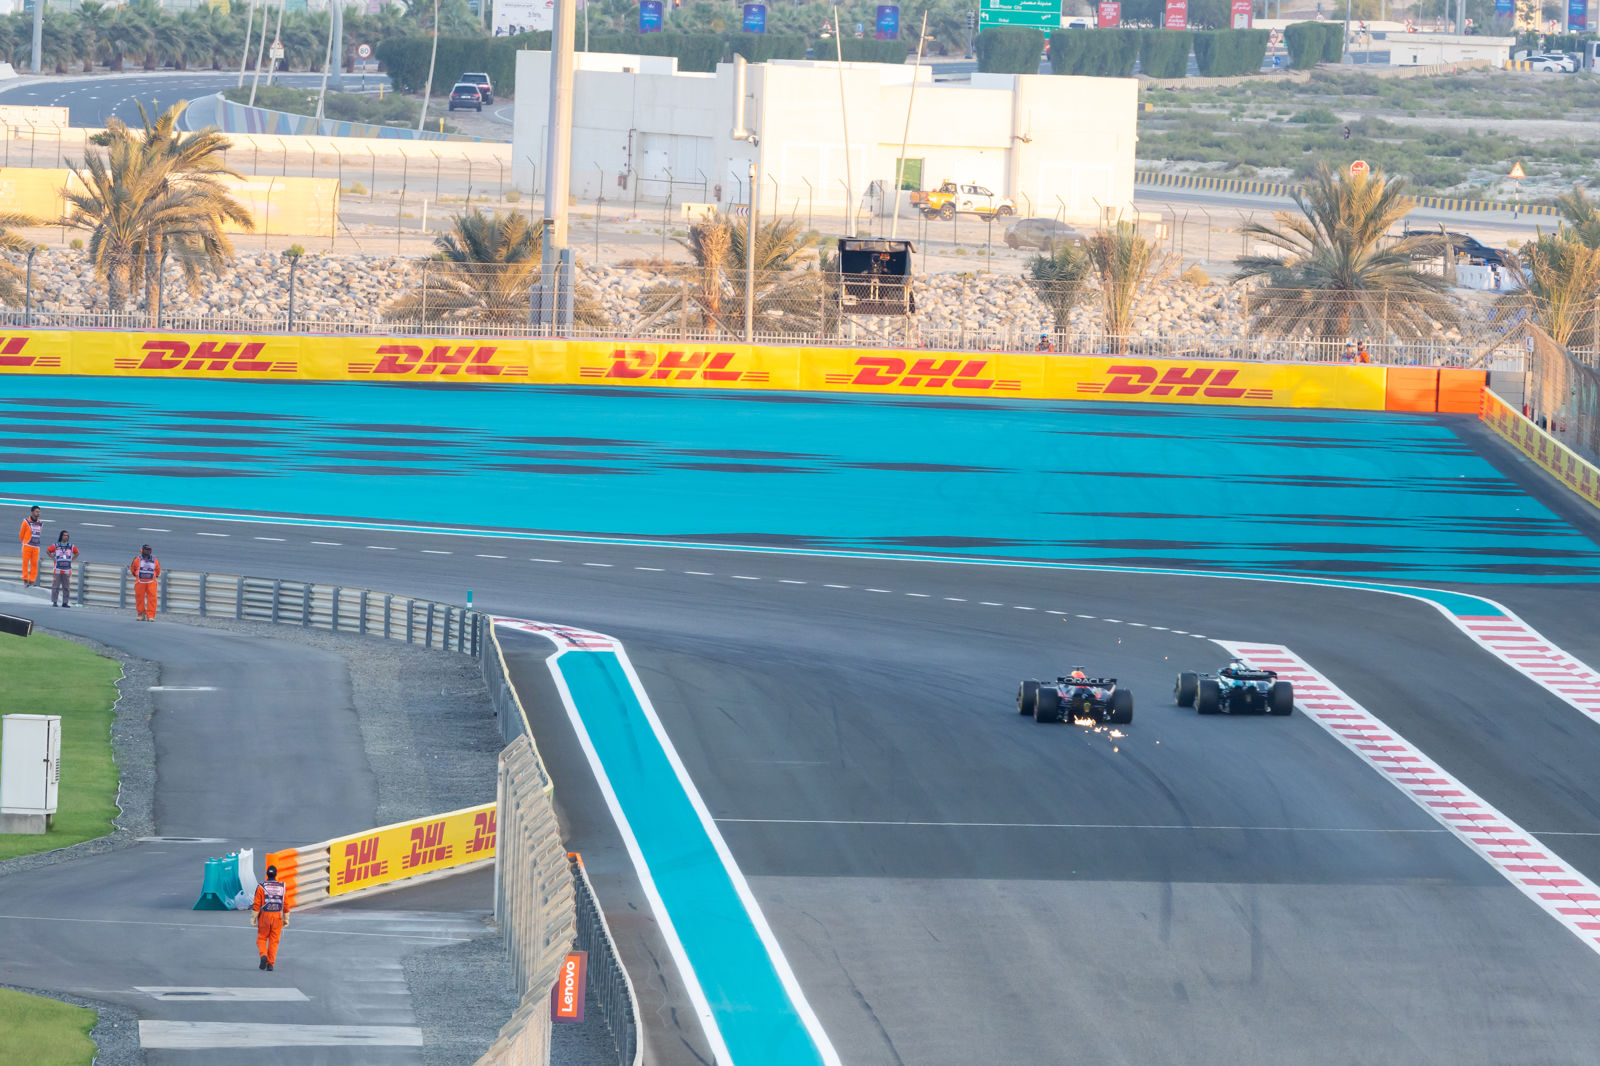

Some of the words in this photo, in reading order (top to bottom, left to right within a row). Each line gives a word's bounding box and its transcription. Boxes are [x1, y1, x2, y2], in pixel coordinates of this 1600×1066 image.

[138, 340, 273, 372] DHL
[372, 344, 506, 376] DHL
[604, 349, 744, 382] DHL
[851, 356, 996, 390] DHL
[1102, 365, 1248, 399] DHL
[1063, 677, 1111, 685] ORACLE
[409, 821, 447, 868] DHL
[472, 810, 497, 853] DH
[343, 836, 382, 885] DHL
[561, 961, 575, 1012] Lenovo
